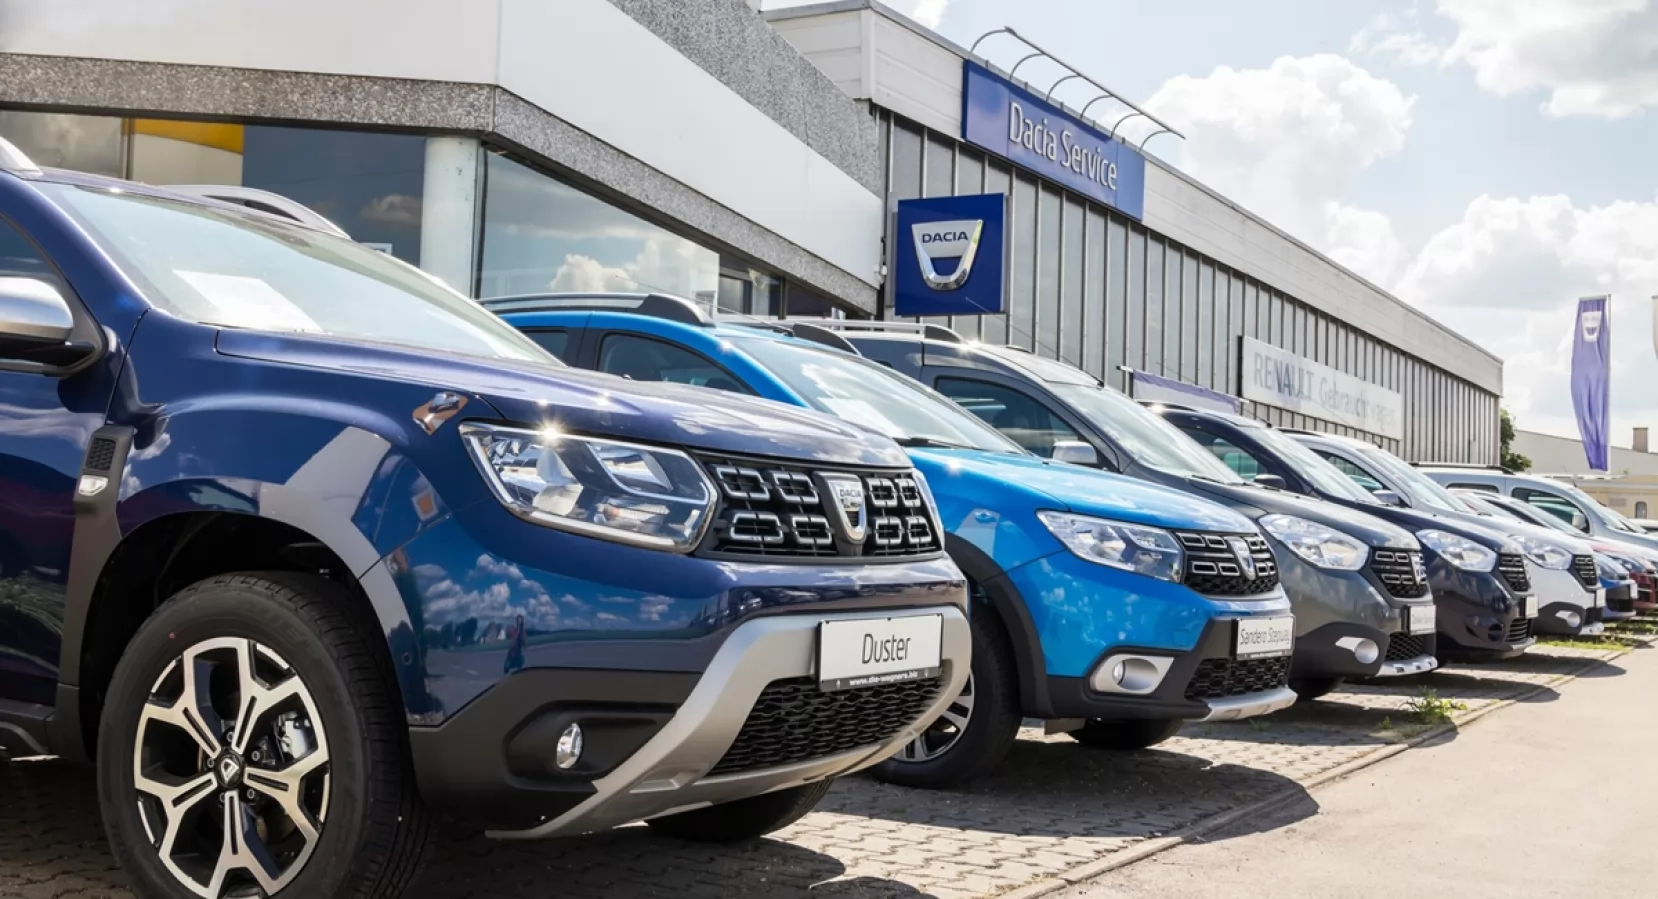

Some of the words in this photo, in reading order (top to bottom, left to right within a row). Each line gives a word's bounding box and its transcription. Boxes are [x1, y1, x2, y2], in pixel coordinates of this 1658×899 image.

[1008, 101, 1057, 162] Dacia
[1061, 130, 1118, 190] Service
[921, 231, 969, 244] DACIA
[1253, 351, 1316, 400] RENAULT
[839, 488, 862, 498] DACIA
[861, 633, 911, 664] Duster
